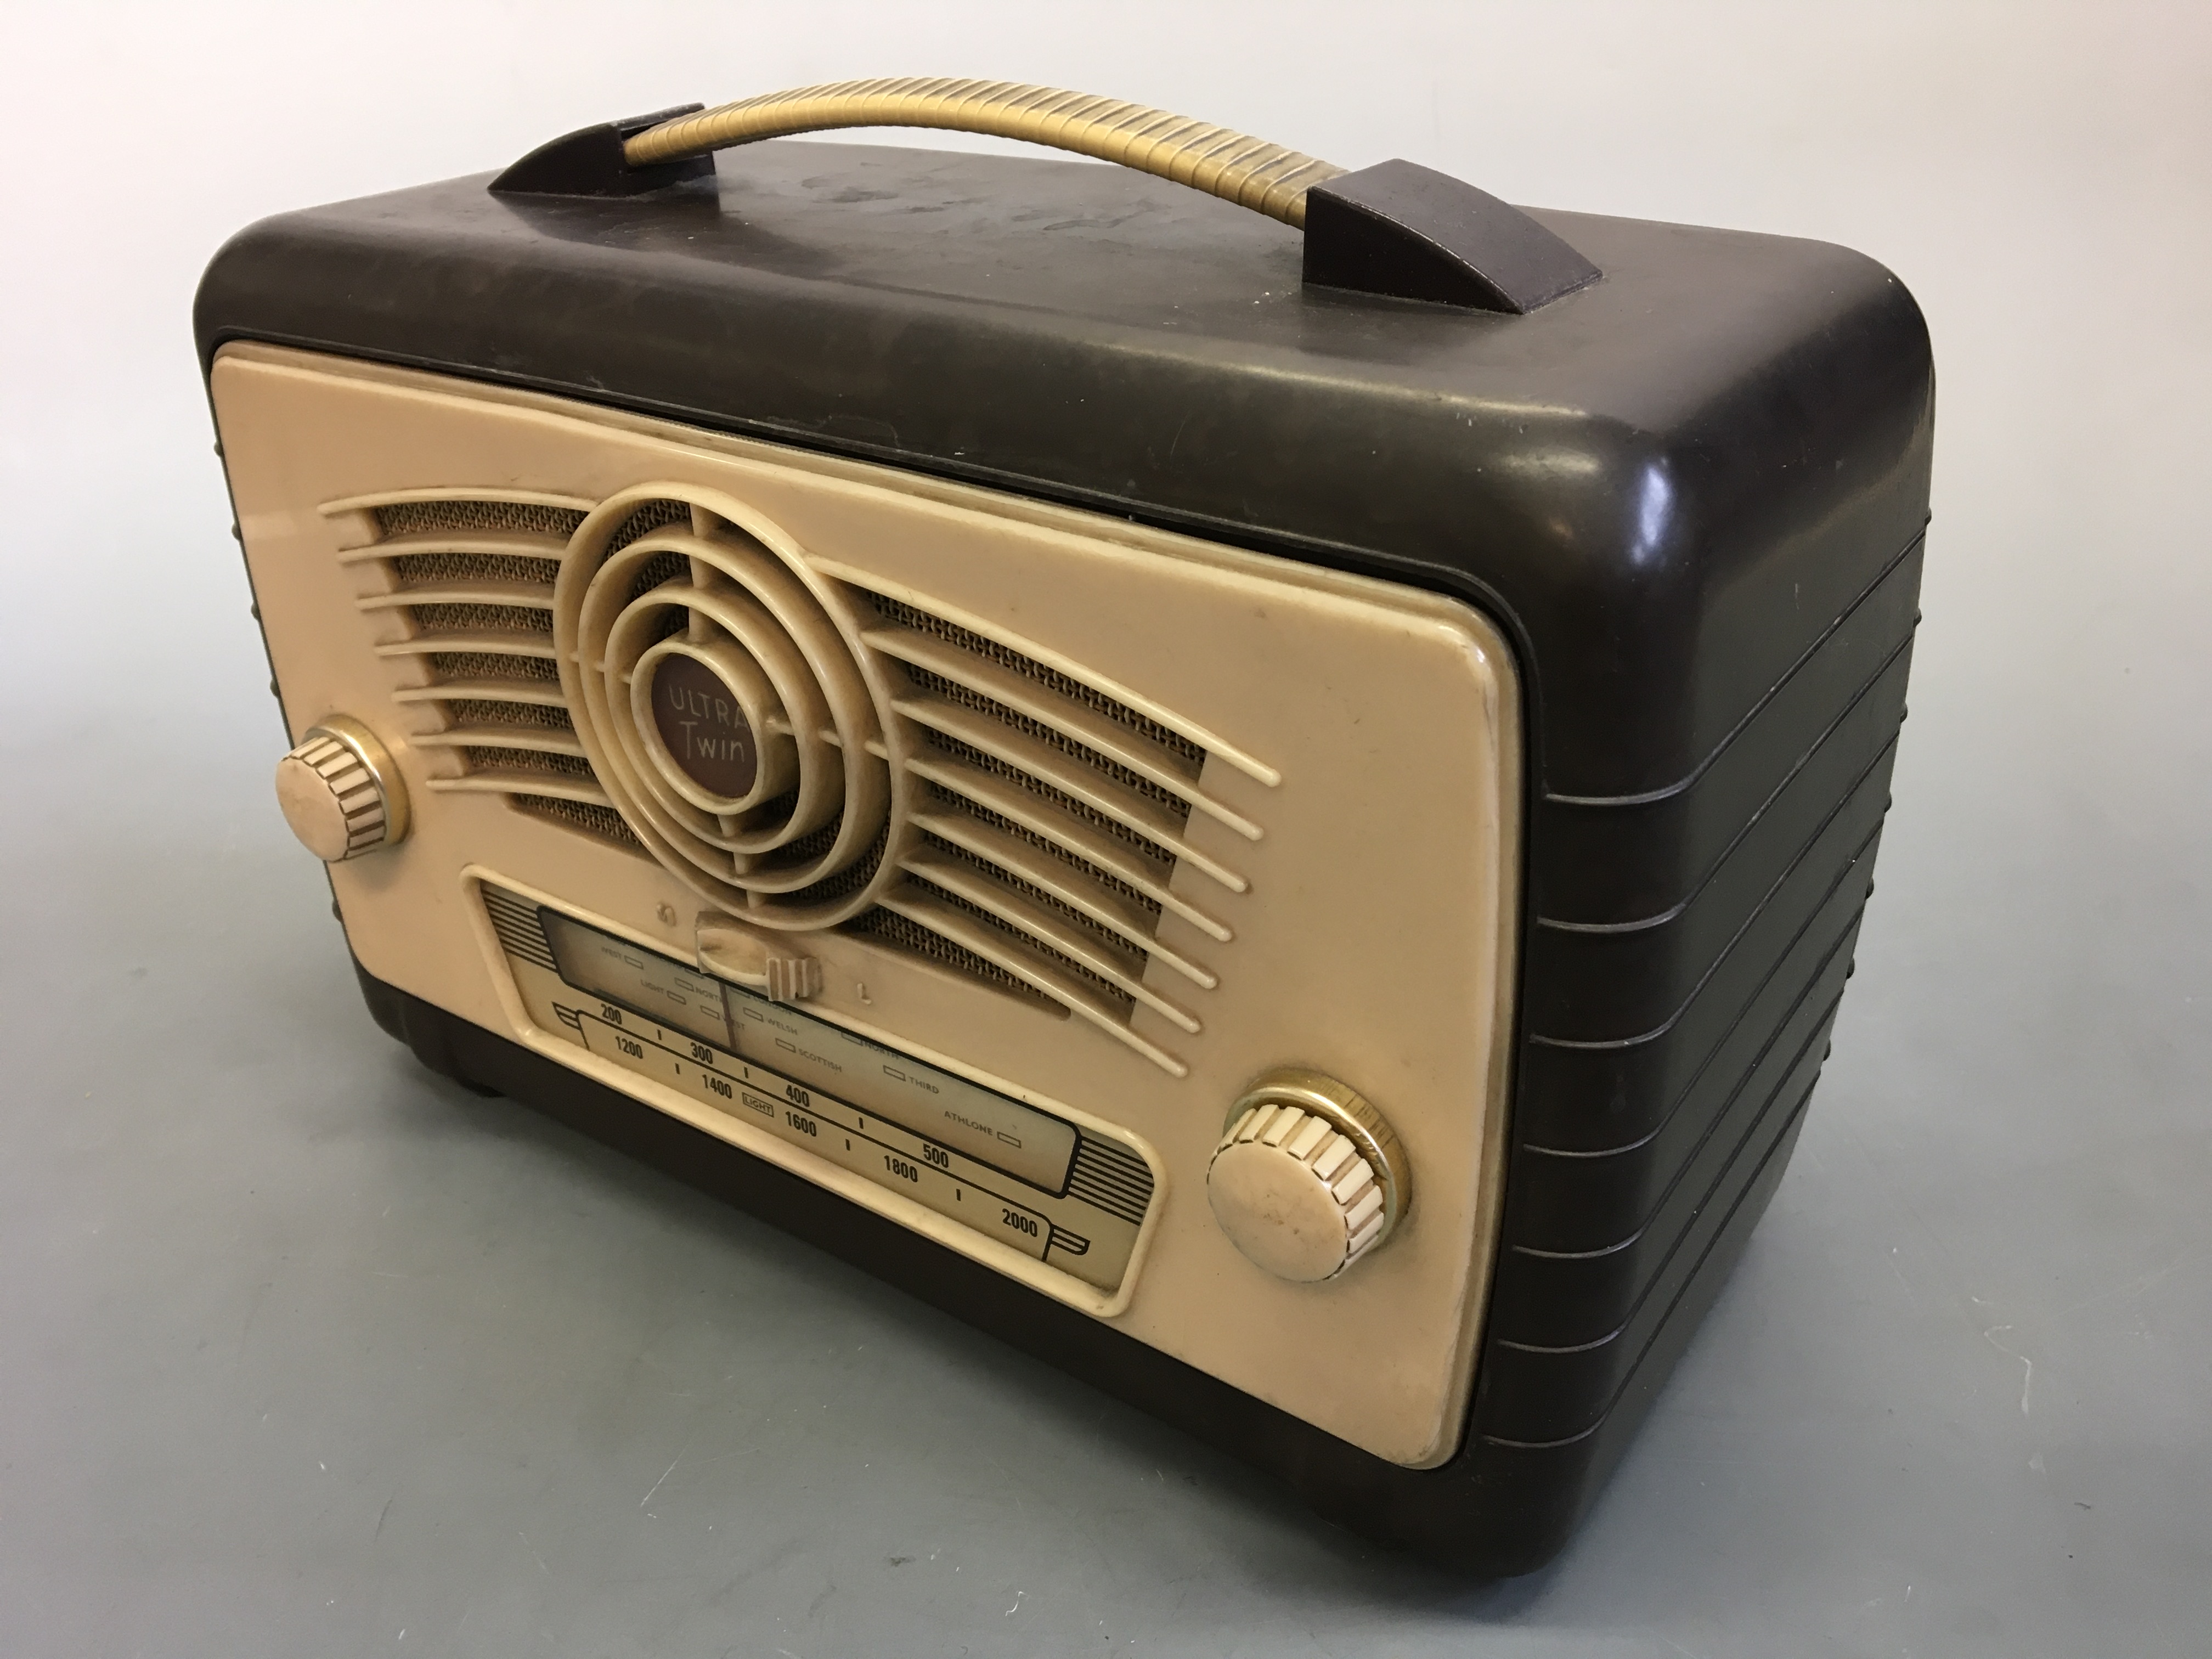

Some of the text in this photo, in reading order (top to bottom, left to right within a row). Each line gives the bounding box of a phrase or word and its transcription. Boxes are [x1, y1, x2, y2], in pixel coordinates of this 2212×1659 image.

[668, 684, 751, 733] ULTRA
[678, 720, 745, 763] Twin
[640, 978, 664, 995] LIGHT
[695, 984, 723, 1003] NORT
[768, 1018, 798, 1035] WELSH
[798, 1048, 842, 1072] SCOTTISH
[600, 1003, 949, 1169] 200 300 400 500
[909, 1076, 940, 1094] THIRD
[944, 1110, 993, 1136] ATHLONE
[614, 1035, 1038, 1238] 1200 1400 LIGHT 1600 1800 2000
